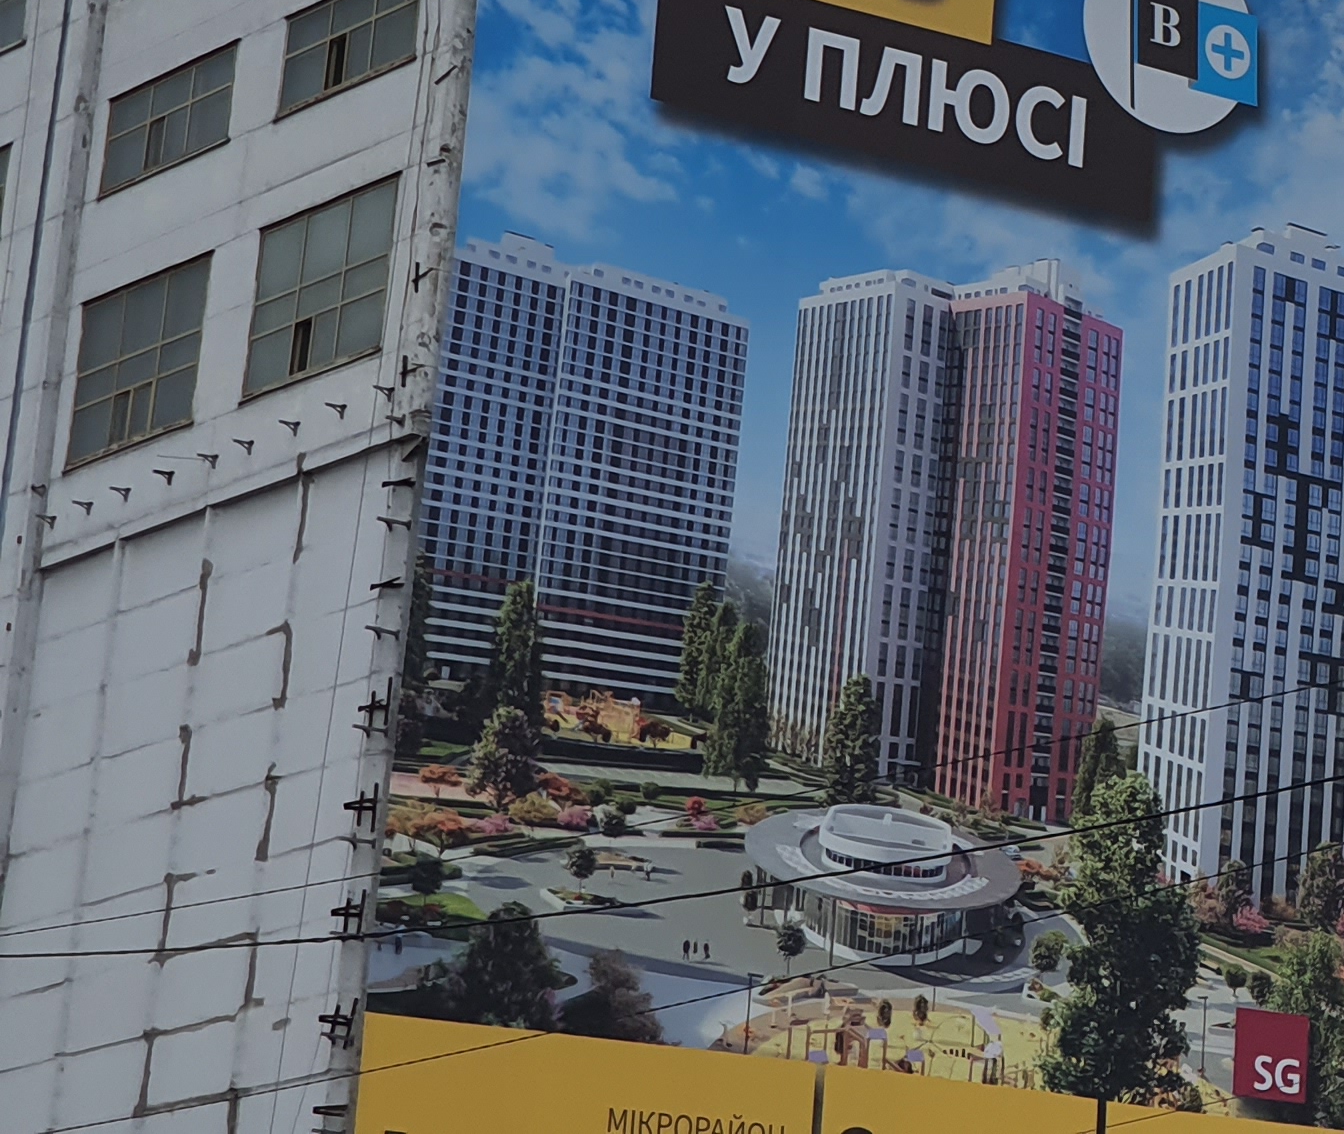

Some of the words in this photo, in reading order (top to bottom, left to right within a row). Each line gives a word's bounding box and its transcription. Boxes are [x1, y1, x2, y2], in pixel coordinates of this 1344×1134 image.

[724, 4, 781, 85] У
[803, 26, 1088, 169] ПЛЮСІ
[1253, 1054, 1300, 1094] SG
